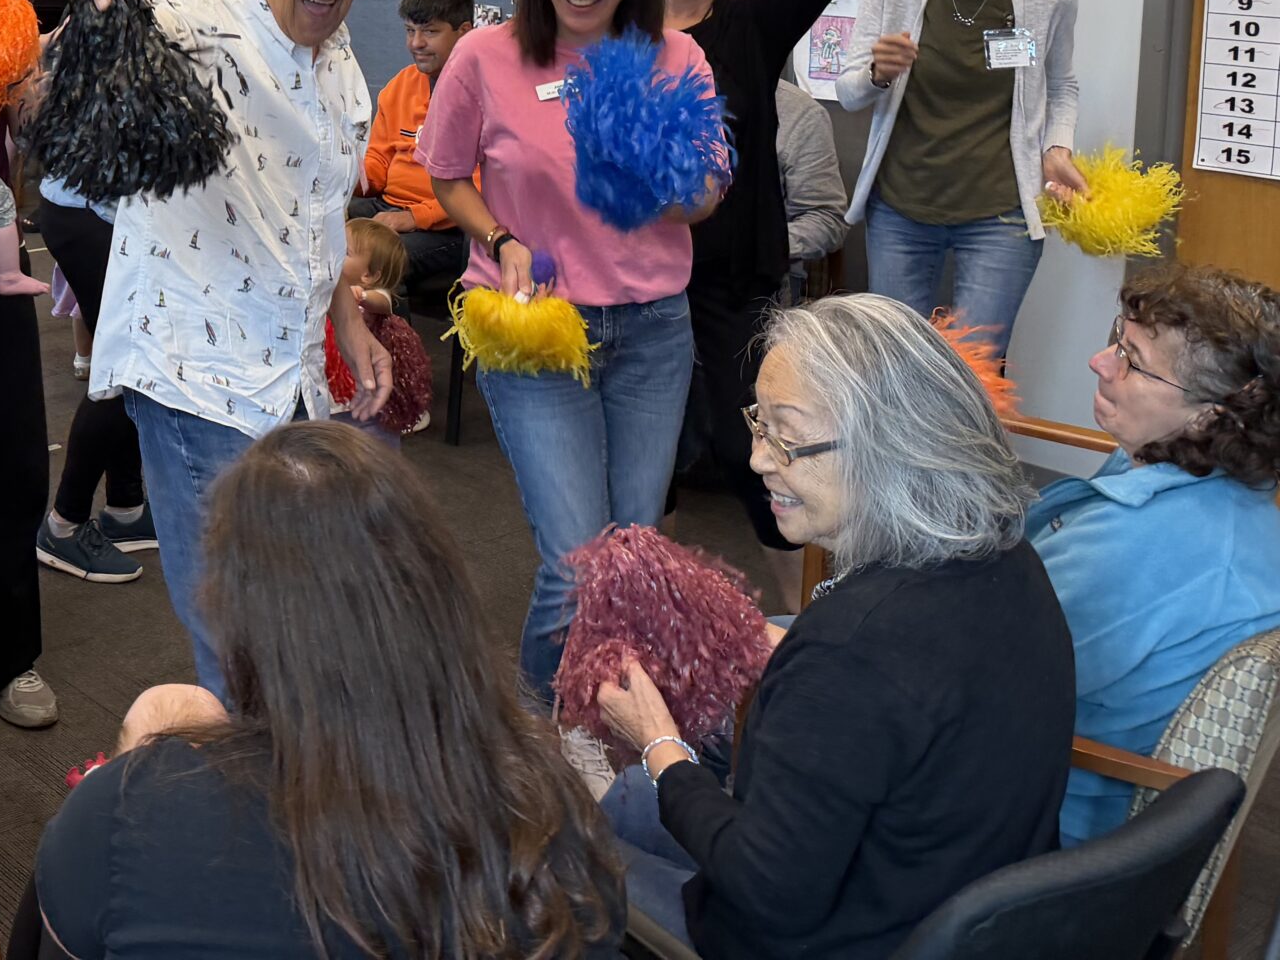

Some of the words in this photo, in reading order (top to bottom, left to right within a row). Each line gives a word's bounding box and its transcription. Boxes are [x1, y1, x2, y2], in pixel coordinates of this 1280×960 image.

[1229, 21, 1260, 37] 10
[1228, 46, 1256, 63] 11
[1226, 71, 1257, 88] 12
[1224, 97, 1254, 114] 13
[1222, 122, 1253, 139] 14
[1221, 147, 1251, 165] 15
